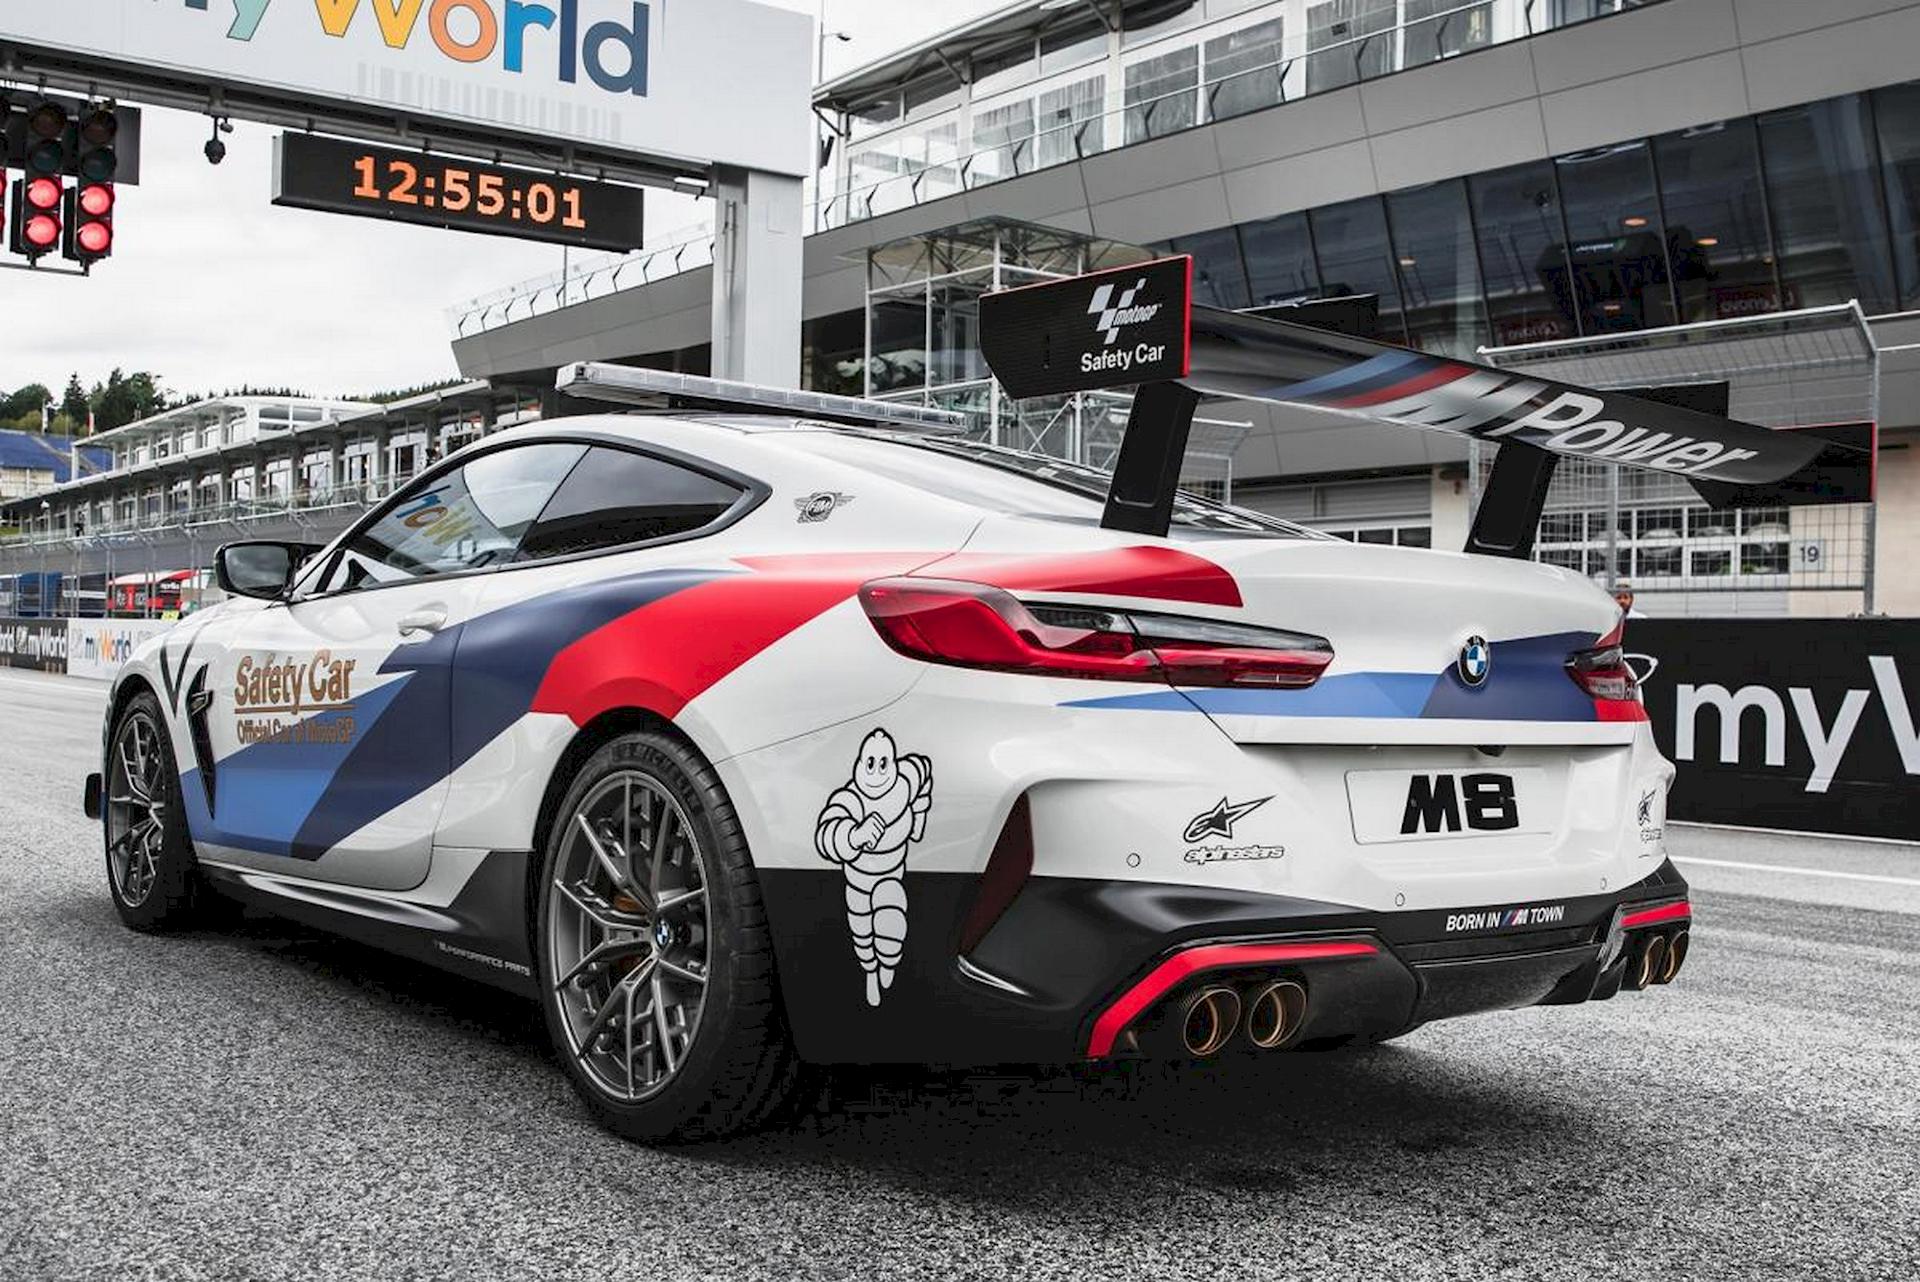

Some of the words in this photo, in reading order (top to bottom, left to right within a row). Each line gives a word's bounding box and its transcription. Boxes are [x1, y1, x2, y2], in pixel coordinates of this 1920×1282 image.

[352, 155, 587, 229] 12:55:01
[1081, 348, 1132, 372] Safety
[1135, 343, 1166, 364] Car
[1484, 390, 1759, 474] Power
[1800, 545, 1820, 564] 19
[27, 627, 67, 661] myWorld
[234, 652, 307, 715] Safety
[308, 649, 357, 702] Car
[1400, 772, 1520, 835] M8
[1183, 844, 1286, 865] alpinestars
[1445, 911, 1486, 932] BORN
[1486, 911, 1502, 928] IN
[1530, 905, 1565, 924] TOWN
